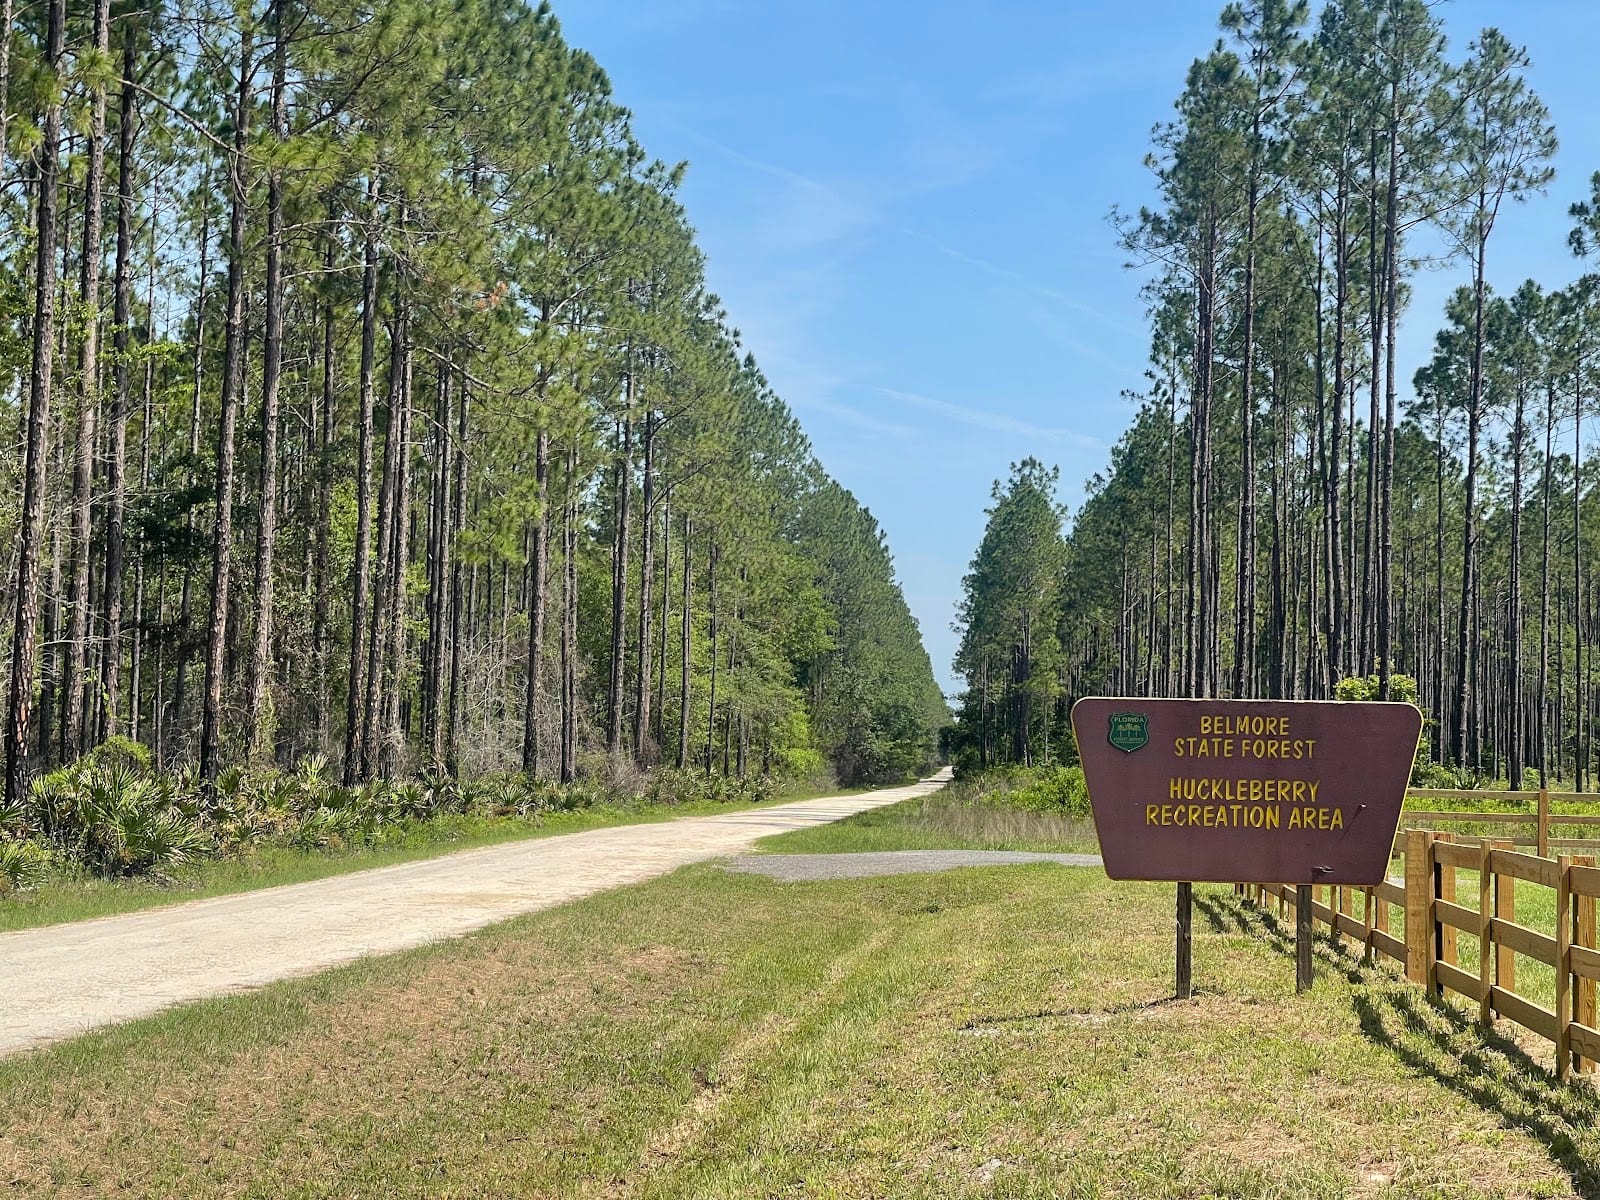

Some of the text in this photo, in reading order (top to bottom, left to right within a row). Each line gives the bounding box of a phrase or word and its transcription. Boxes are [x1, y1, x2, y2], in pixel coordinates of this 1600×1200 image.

[1200, 715, 1290, 736] BELMORE
[1174, 737, 1317, 759] STATE FOREST
[1169, 777, 1321, 802] HUCKLEBERRY
[1146, 803, 1344, 831] RECREATION AREA
